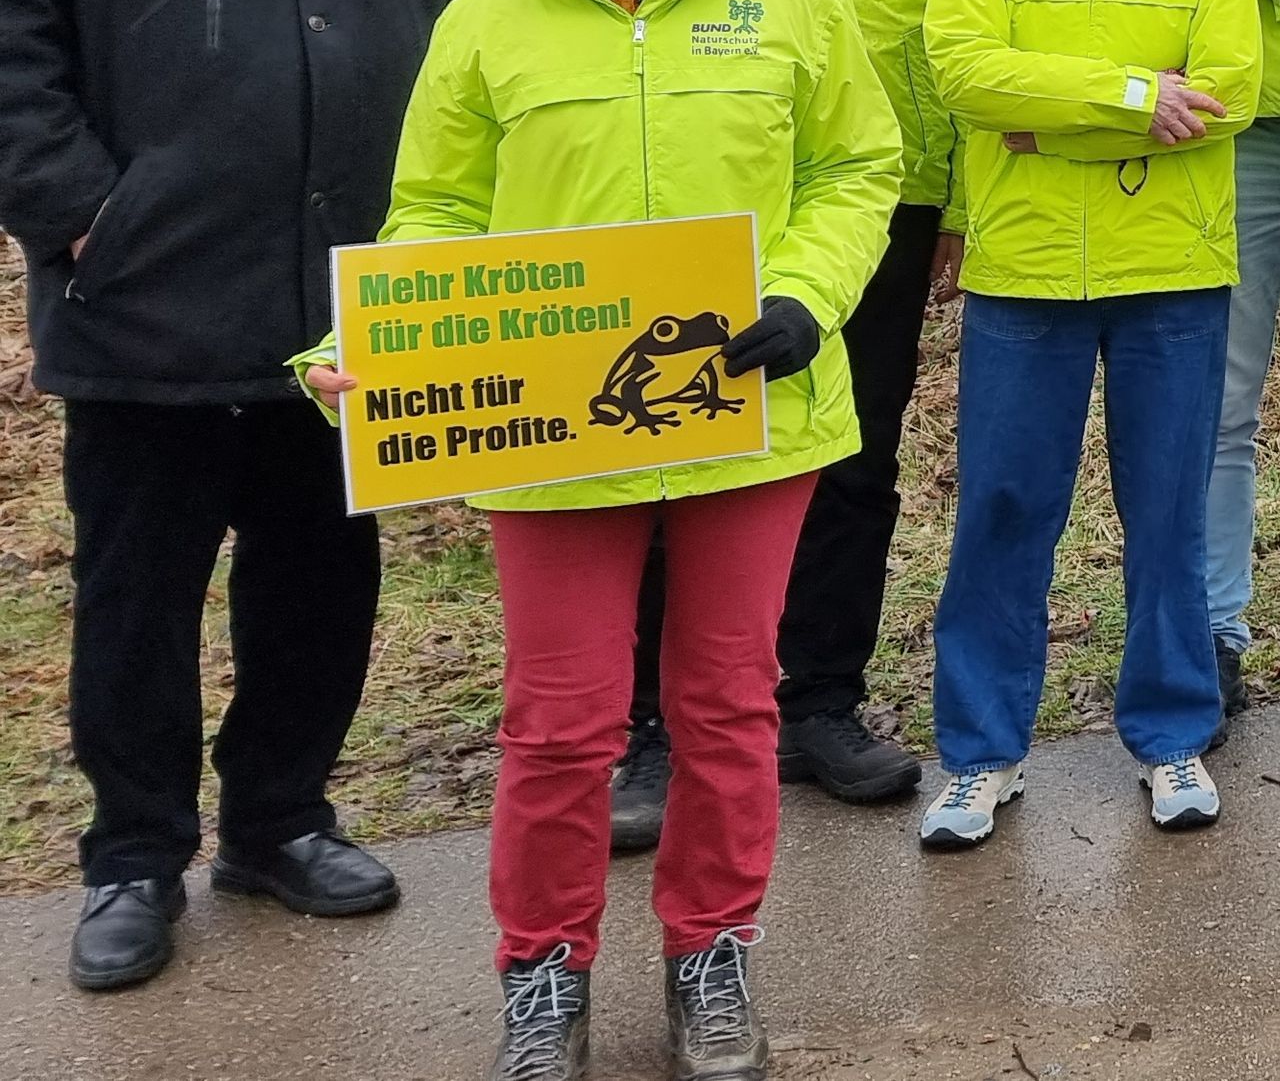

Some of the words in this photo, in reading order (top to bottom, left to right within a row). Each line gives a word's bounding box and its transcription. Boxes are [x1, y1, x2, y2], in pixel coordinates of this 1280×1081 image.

[691, 23, 731, 33] BUND
[692, 36, 759, 45] Naturschutz
[692, 46, 701, 55] in
[704, 46, 740, 57] Bayern
[744, 47, 760, 55] e.V.
[359, 271, 454, 307] Mehr
[464, 258, 585, 299] Kröten
[368, 321, 422, 354] für
[432, 314, 490, 349] die
[499, 297, 631, 342] Kröten!
[366, 383, 465, 422] Nicht
[471, 375, 524, 409] für
[378, 433, 437, 467] die
[446, 416, 577, 459] Profite.
